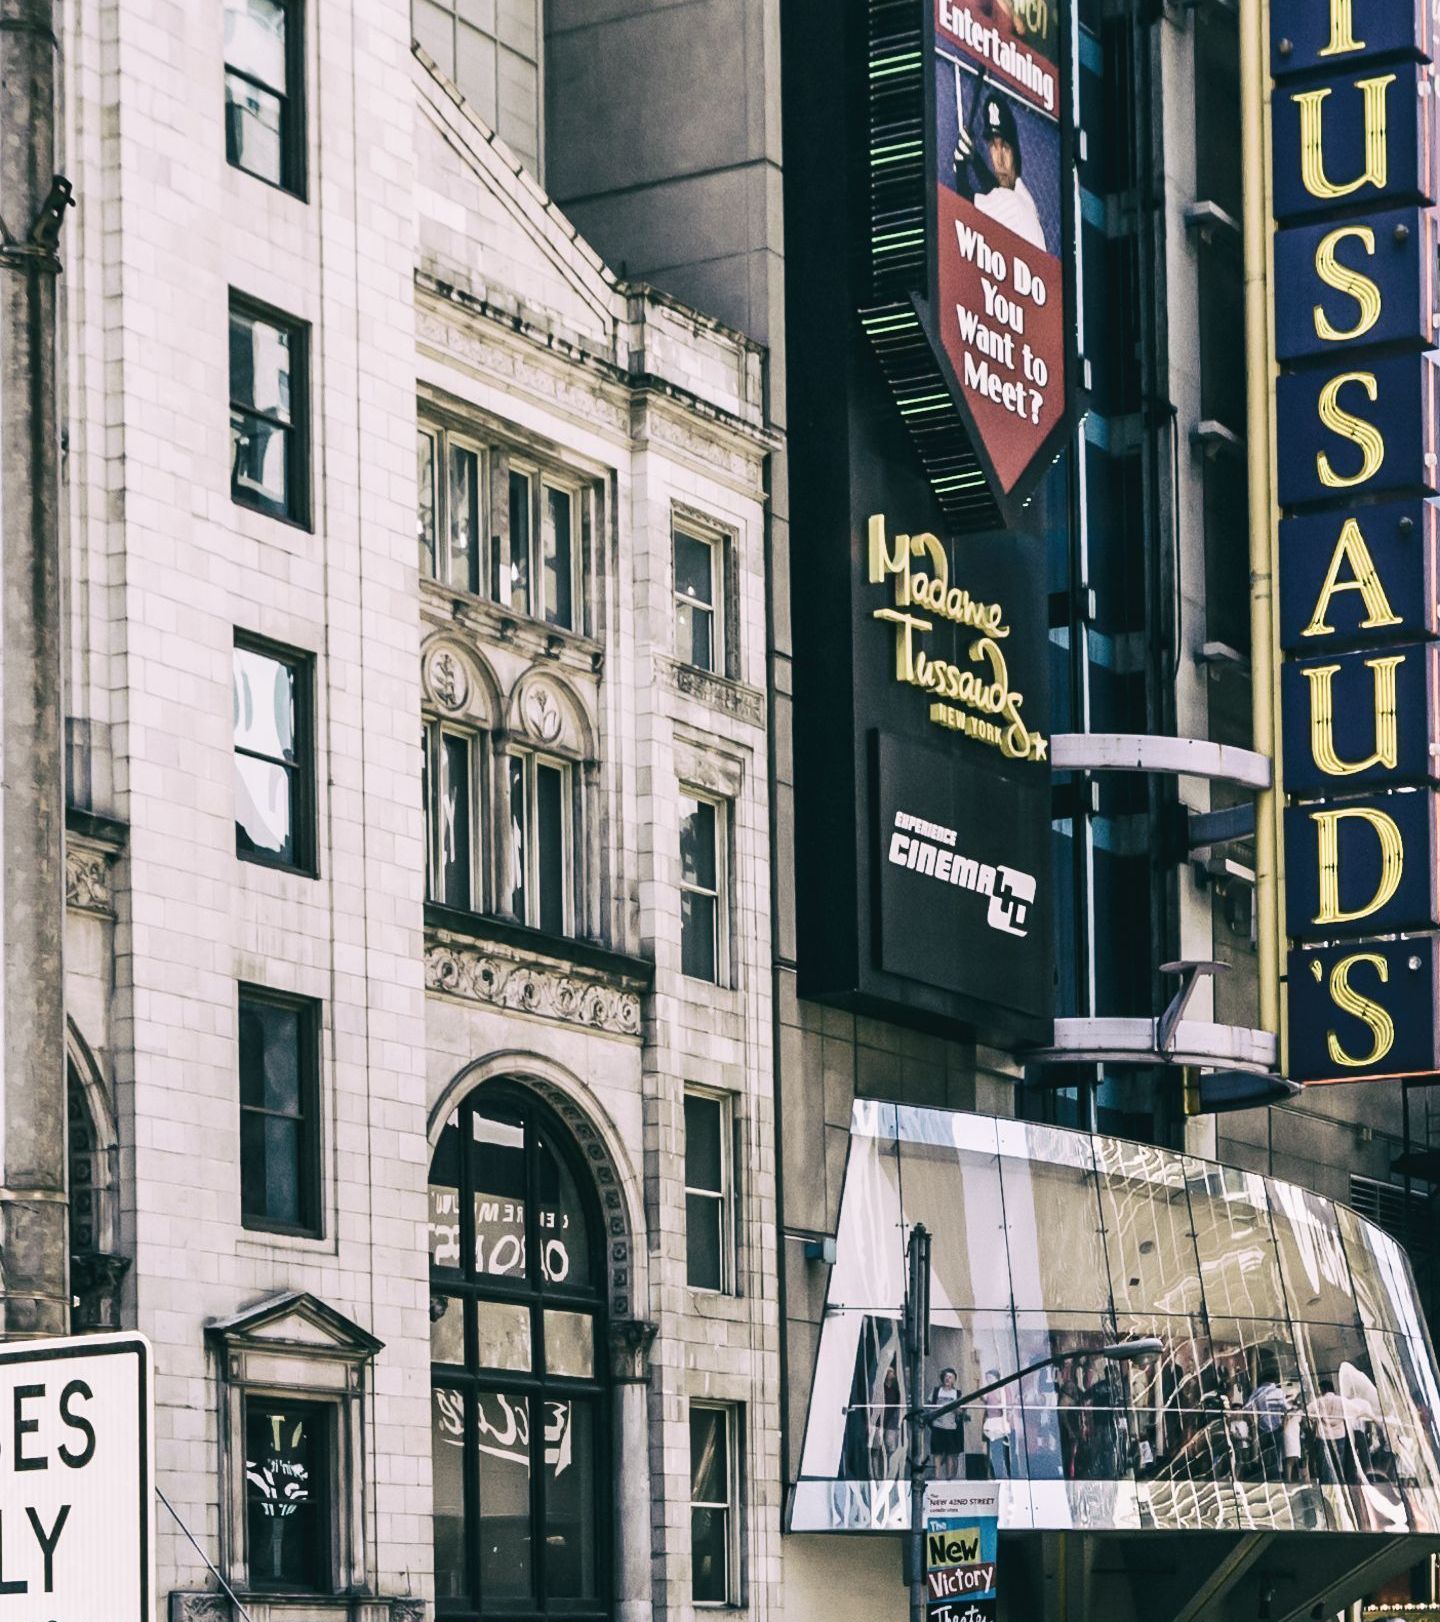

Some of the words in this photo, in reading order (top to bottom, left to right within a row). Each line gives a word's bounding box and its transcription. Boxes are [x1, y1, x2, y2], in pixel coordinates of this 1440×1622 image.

[939, 0, 1054, 111] Entertaining
[954, 219, 1007, 282] Who
[1013, 257, 1047, 307] Do
[980, 277, 1024, 335] You
[956, 304, 1015, 370] Want
[1024, 343, 1048, 388] to
[964, 353, 1045, 425] Meet?
[868, 513, 1010, 638] Madame
[873, 608, 1035, 760] Tussauds
[930, 703, 965, 733] NEW
[966, 714, 1003, 747] YORK
[888, 832, 997, 896] CINEMA
[929, 1534, 978, 1565] New
[930, 1521, 947, 1532] The
[929, 1566, 993, 1598] Victory
